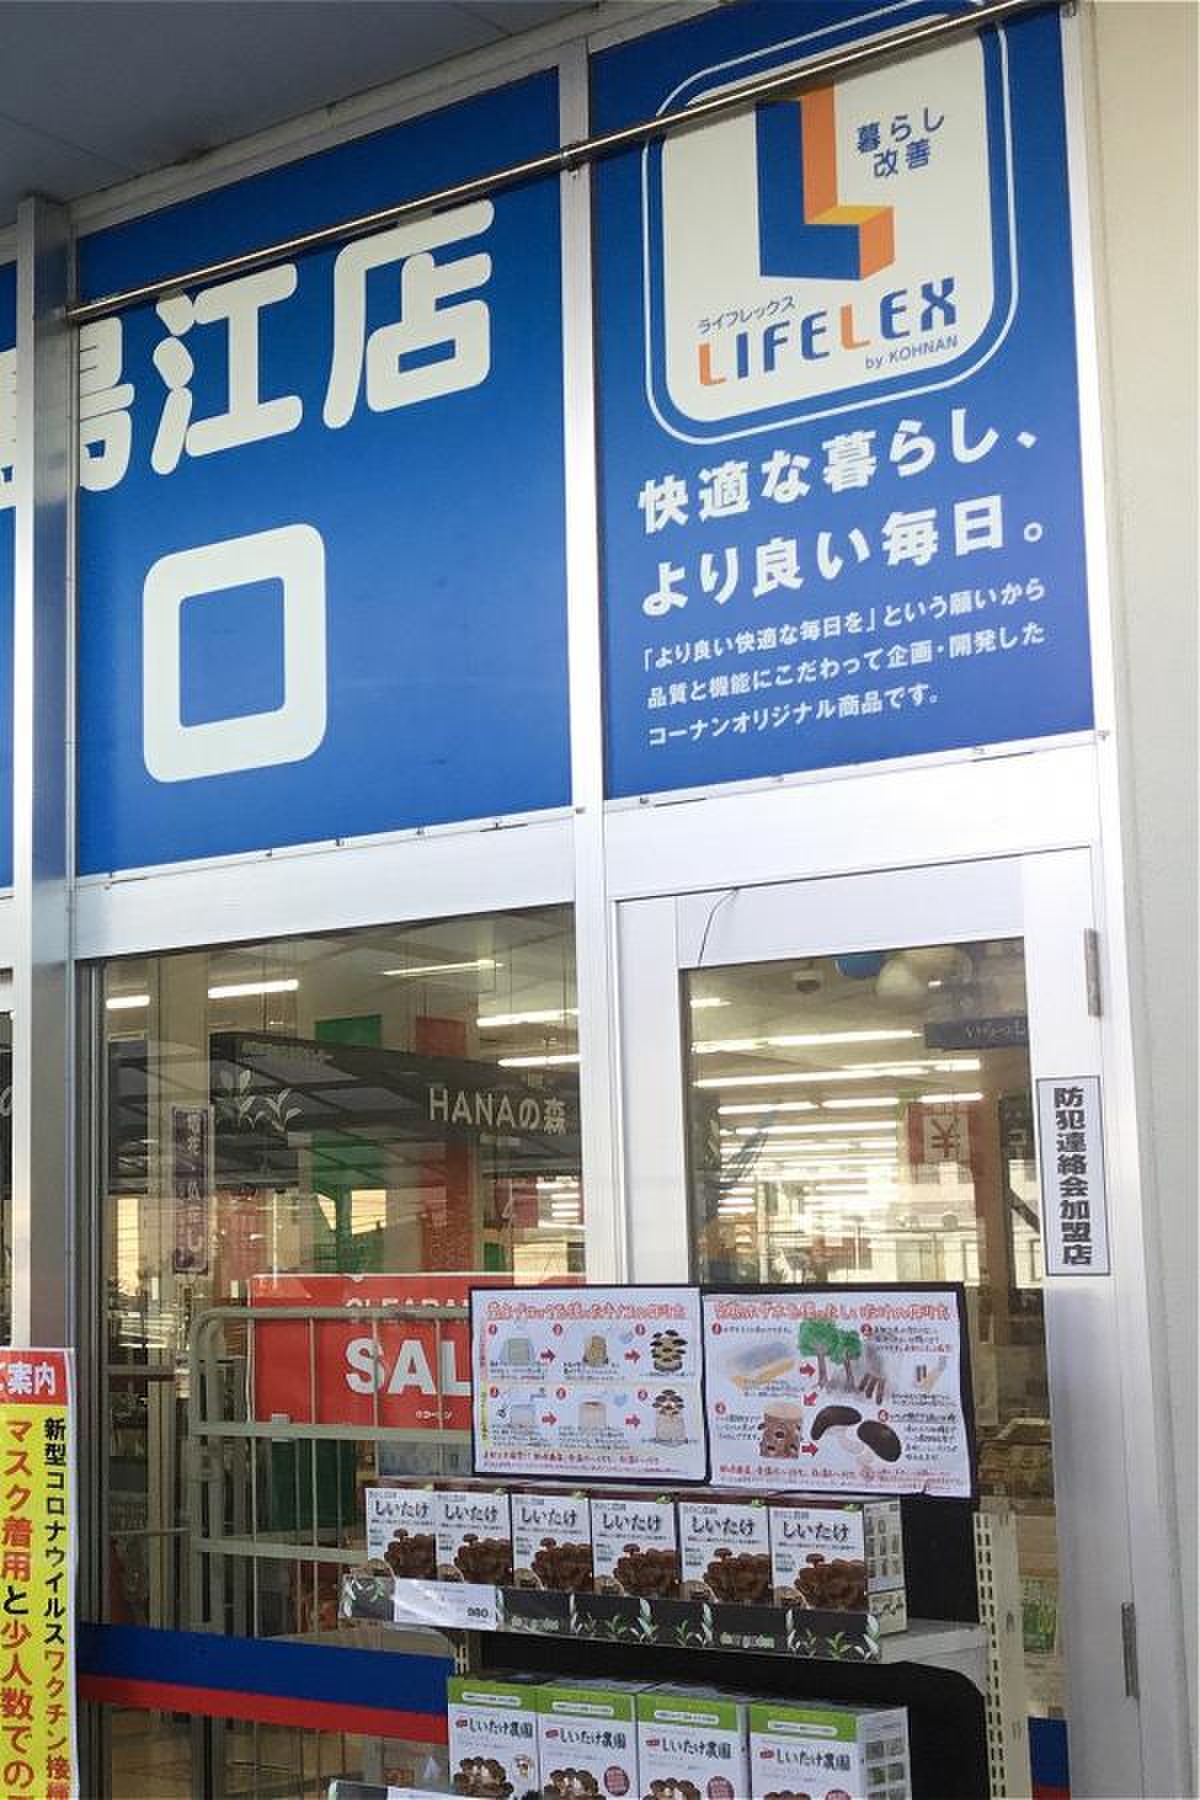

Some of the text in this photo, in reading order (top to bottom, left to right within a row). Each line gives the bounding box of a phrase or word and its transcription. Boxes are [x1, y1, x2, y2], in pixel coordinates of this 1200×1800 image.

[857, 106, 944, 154] 暮らし
[873, 141, 931, 178] 改善
[698, 277, 957, 386] LIFELEX
[865, 334, 959, 370] by KOHNAN
[639, 408, 1039, 534] 快適な暮らし、
[642, 495, 1043, 616] より良い毎日。
[648, 682, 939, 746] コーナンオリジナル商品です。
[429, 1085, 567, 1135] HANAの森
[1054, 1086, 1092, 1266] 防犯連絡会加盟店
[374, 1500, 429, 1518] しいたけ
[444, 1503, 498, 1520] しいたけ
[521, 1507, 577, 1527] しいたけ
[603, 1513, 662, 1533] しいたけ
[691, 1516, 755, 1536] しいたけ
[783, 1521, 849, 1543] しいたけ
[0, 1419, 35, 1800] マスク着用と少人数での
